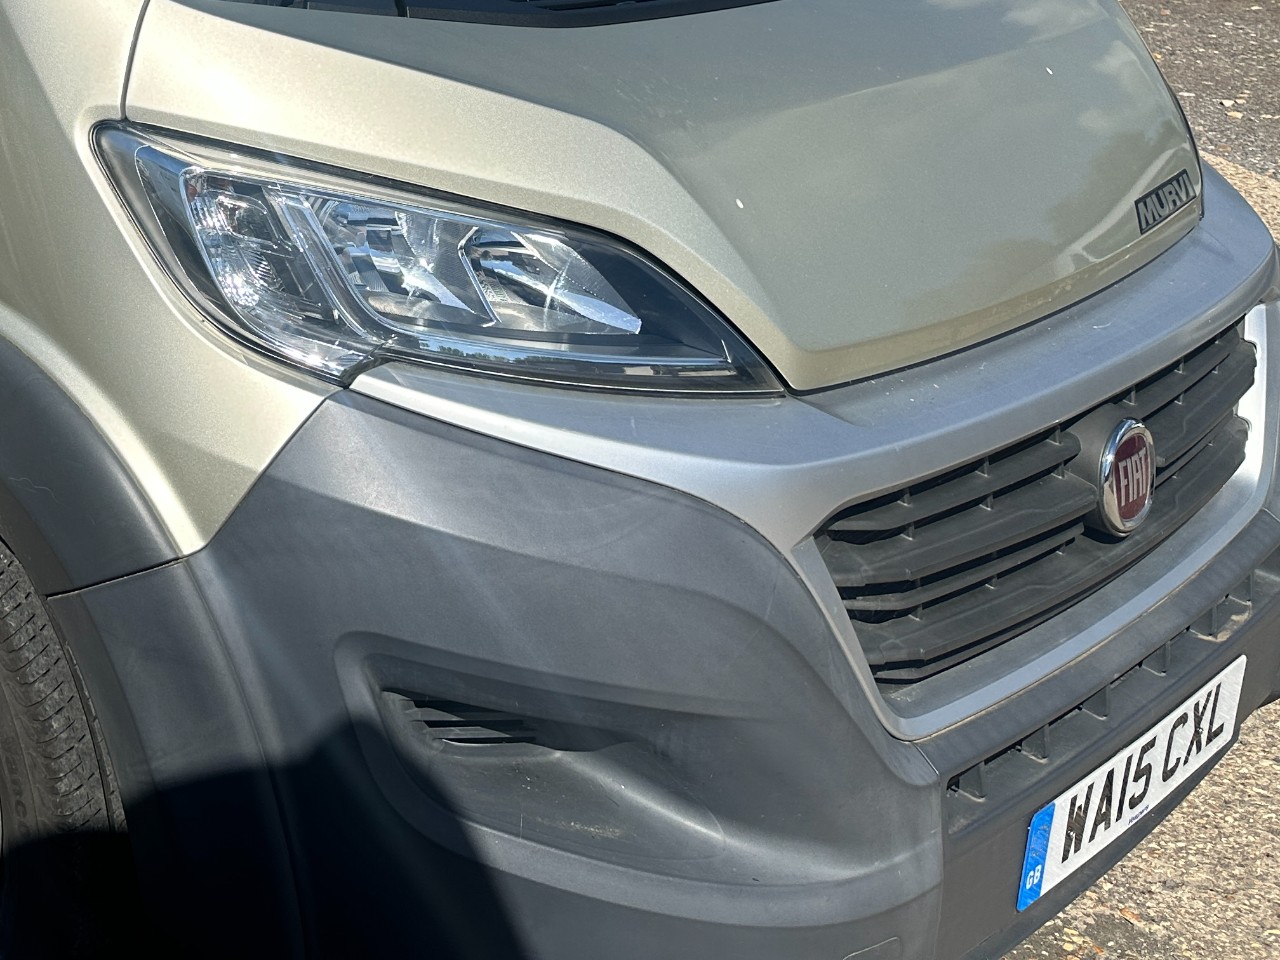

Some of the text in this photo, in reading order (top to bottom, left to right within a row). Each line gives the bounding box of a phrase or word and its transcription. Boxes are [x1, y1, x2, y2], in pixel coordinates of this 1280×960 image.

[1137, 173, 1196, 230] MURVI
[1118, 446, 1147, 507] FIAT
[1061, 682, 1224, 864] WA15 CXL
[1026, 864, 1042, 890] GB
